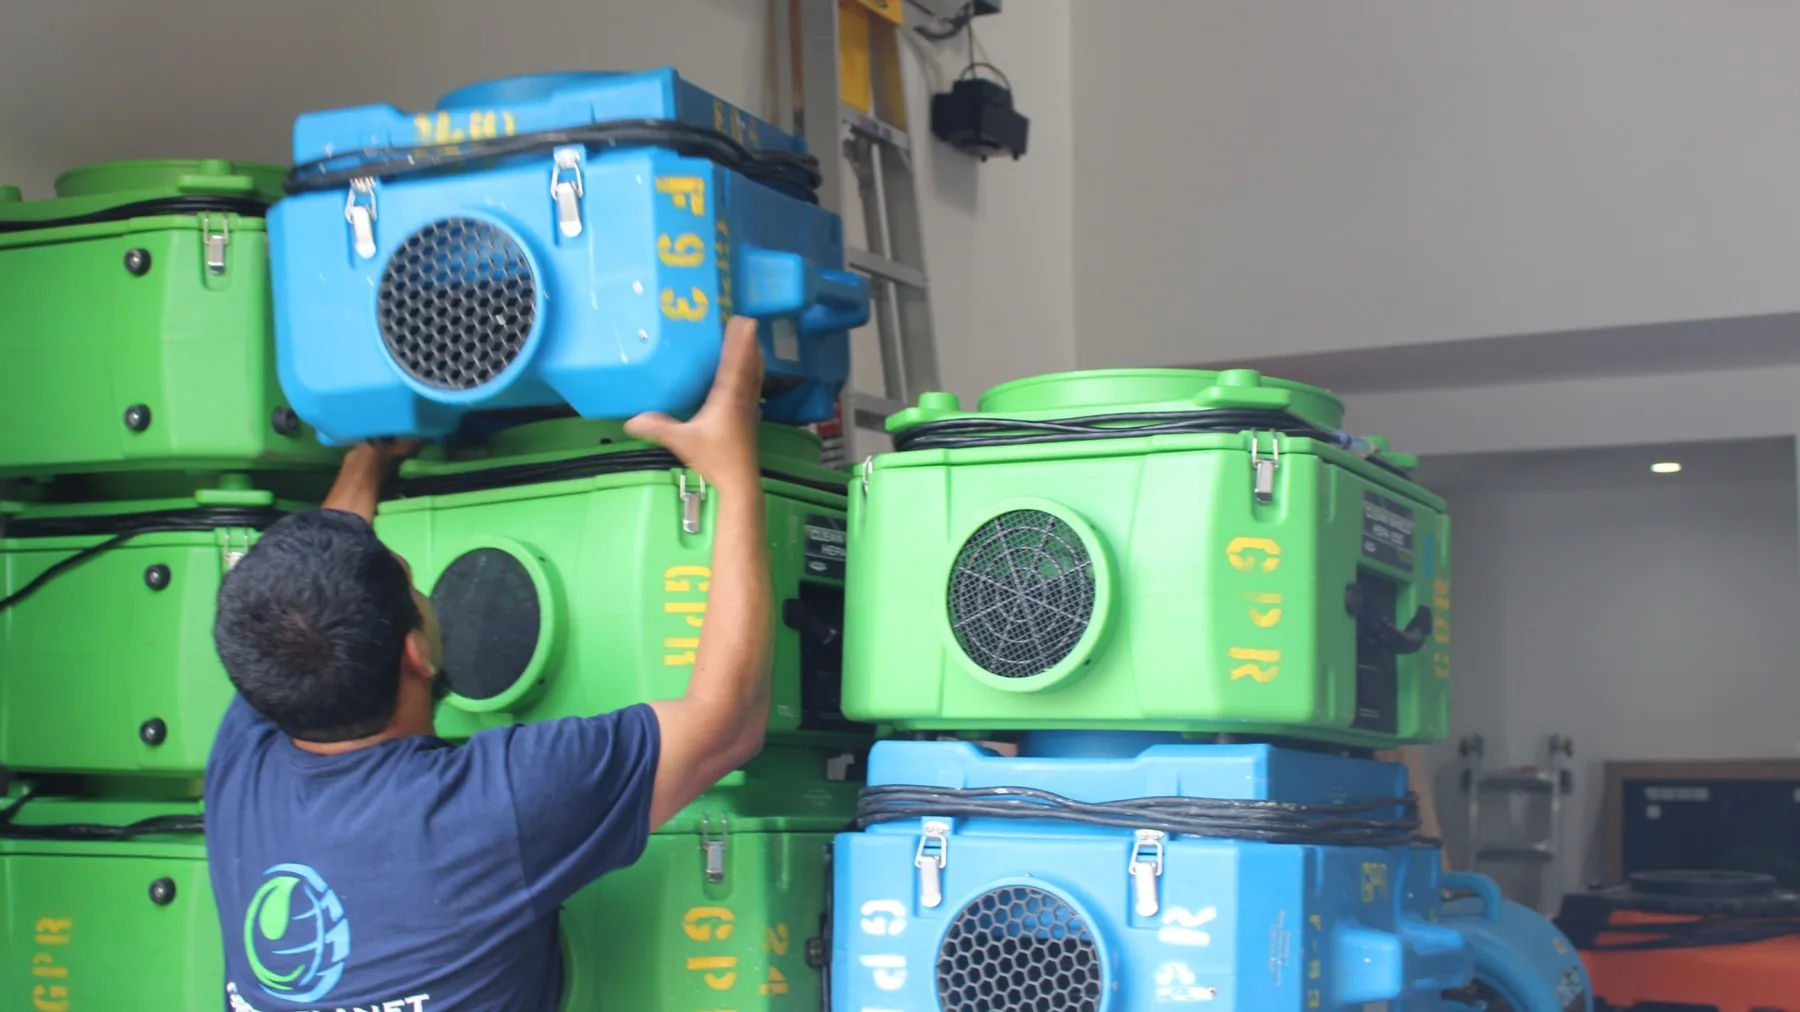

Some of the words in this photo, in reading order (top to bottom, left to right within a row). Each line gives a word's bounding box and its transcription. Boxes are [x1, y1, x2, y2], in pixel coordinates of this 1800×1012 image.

[655, 176, 708, 322] F93
[683, 906, 738, 1012] GP
[859, 900, 908, 1012] GP
